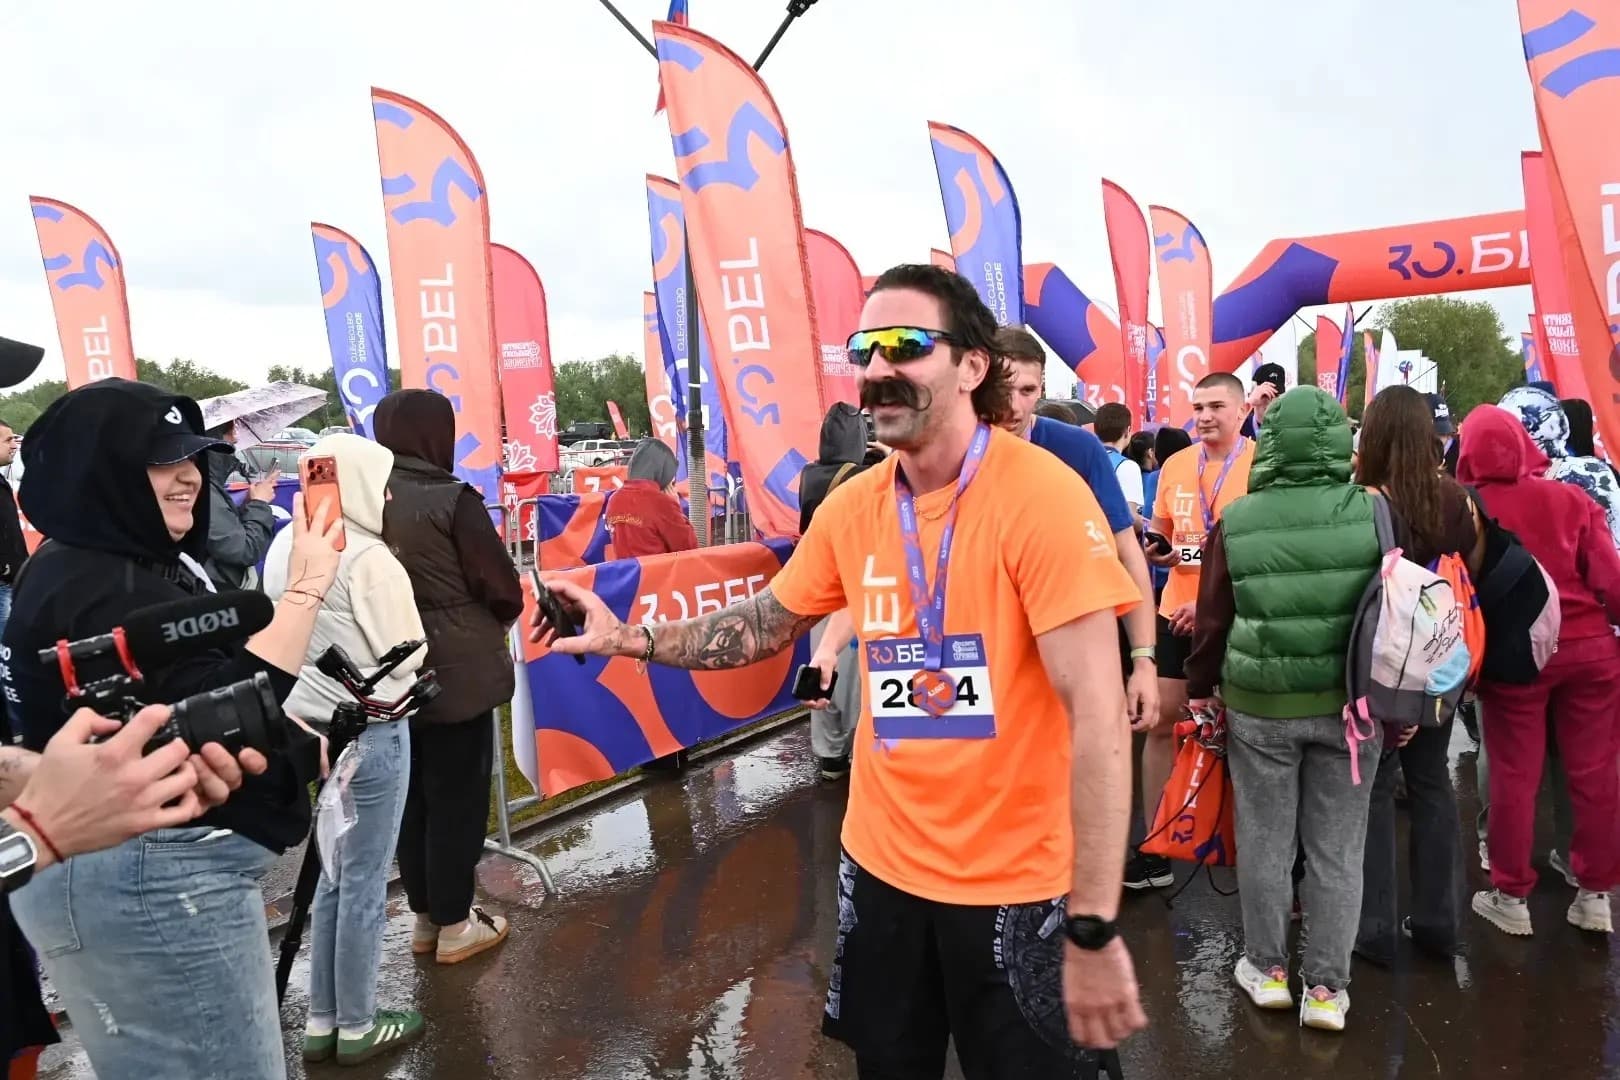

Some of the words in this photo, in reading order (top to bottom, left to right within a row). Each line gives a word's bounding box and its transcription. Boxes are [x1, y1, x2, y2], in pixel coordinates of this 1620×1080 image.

[862, 554, 899, 634] ЕГ
[161, 607, 240, 643] RØDE
[870, 643, 926, 665] ЗО.БЕ
[880, 675, 979, 709] 24
